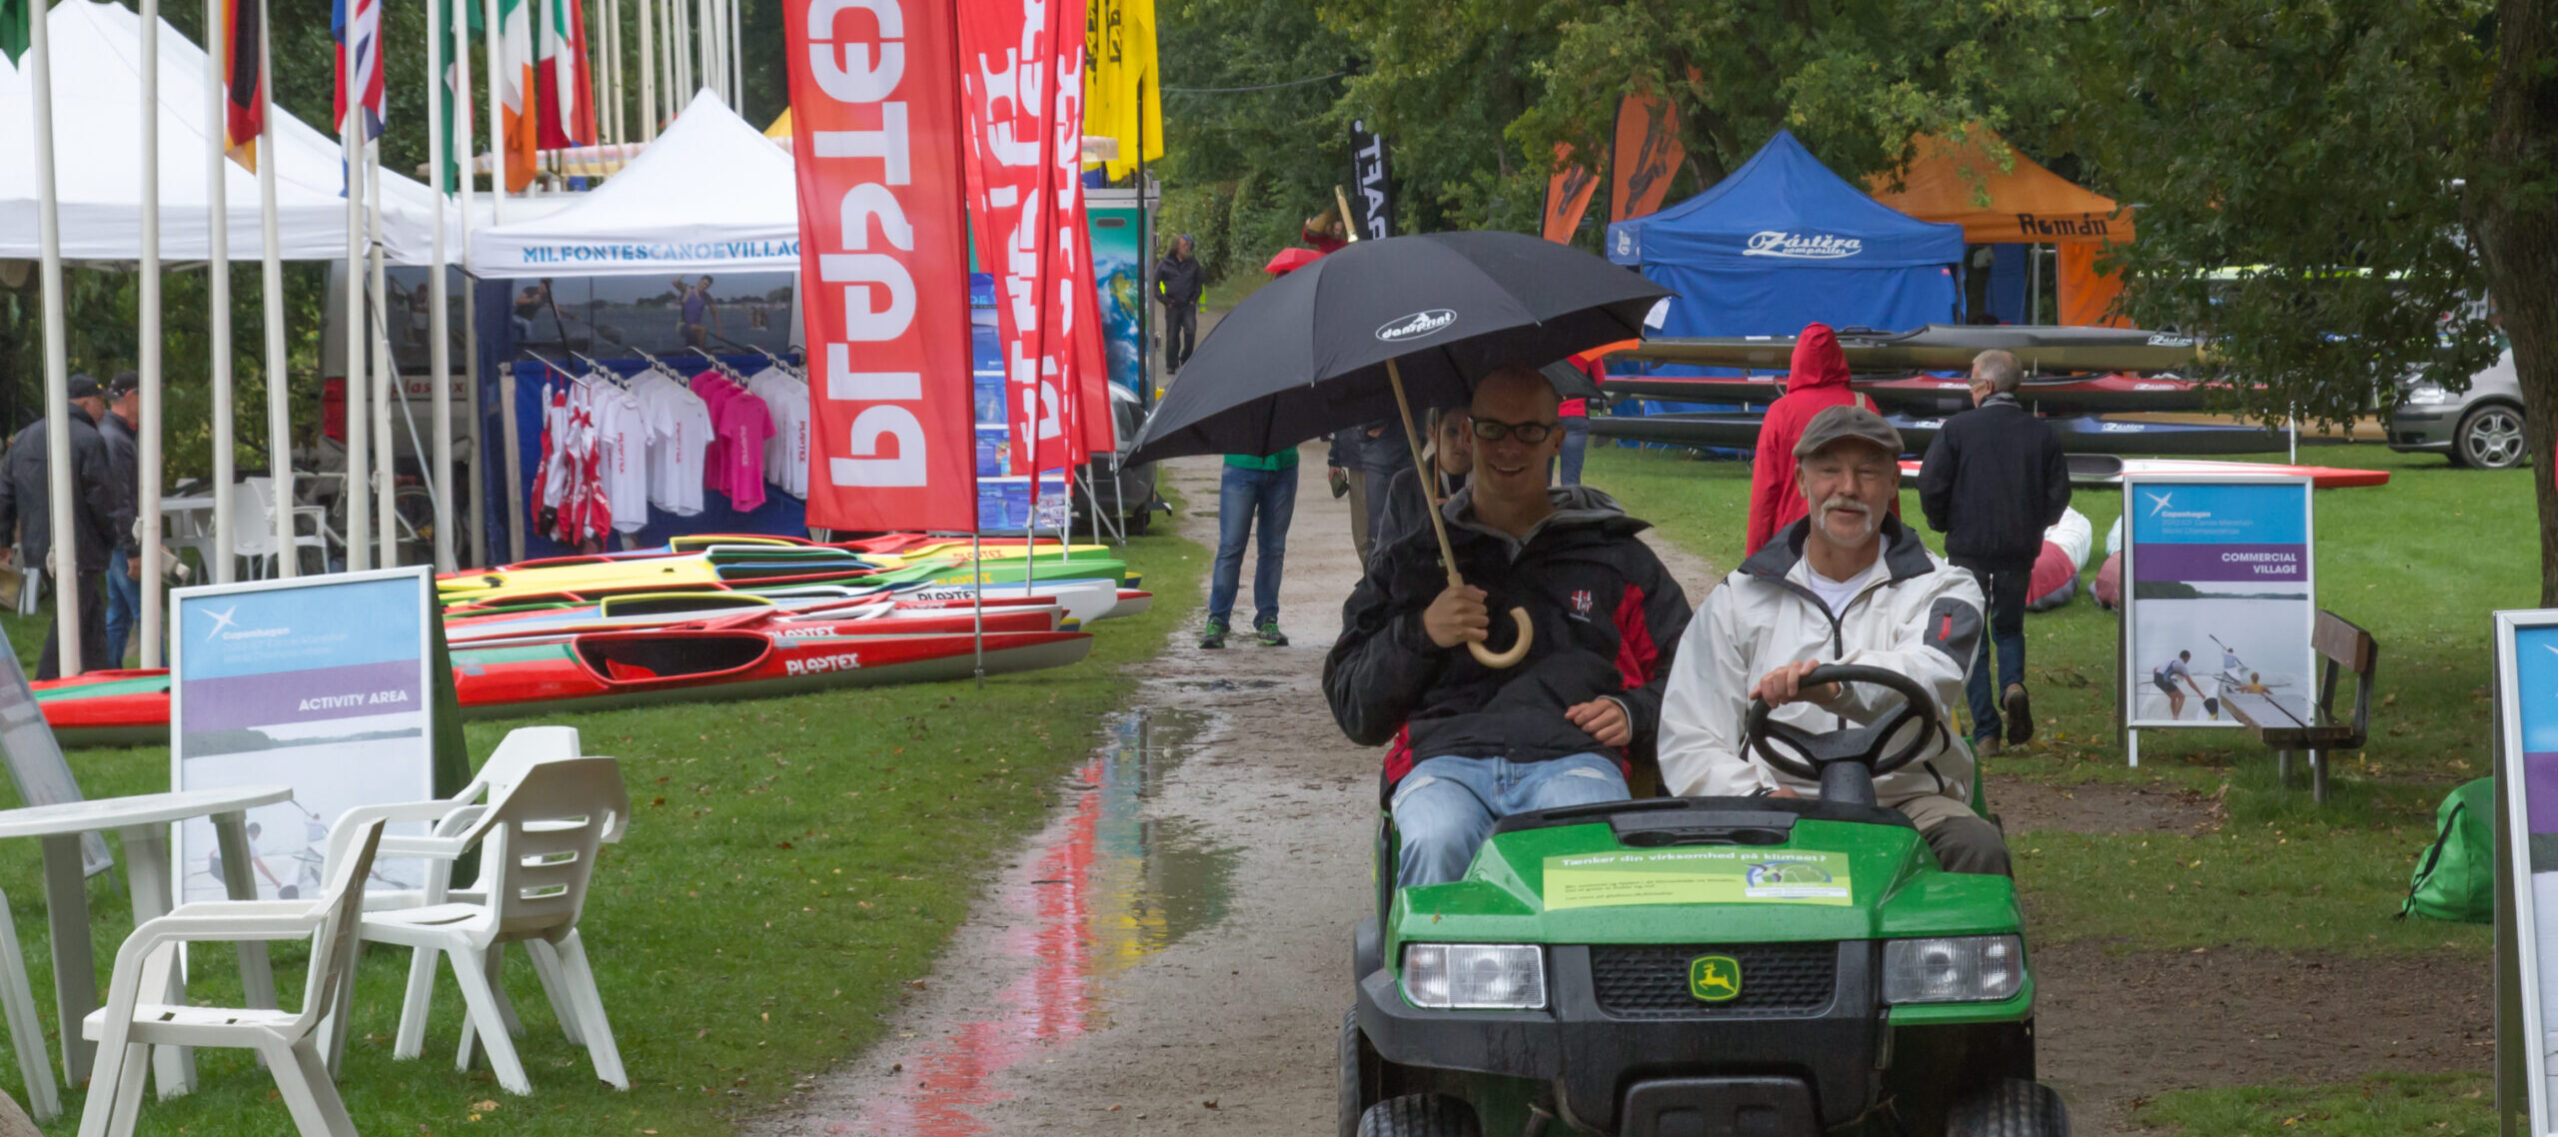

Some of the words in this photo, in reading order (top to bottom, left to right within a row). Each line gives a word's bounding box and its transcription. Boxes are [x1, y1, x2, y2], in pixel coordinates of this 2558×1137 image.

[2221, 553, 2297, 562] COMMERCIAL
[2253, 565, 2297, 574] VILLAGE
[785, 653, 861, 676] PLASTEX
[298, 694, 365, 711] ACTIVITY
[368, 690, 408, 704] AREA
